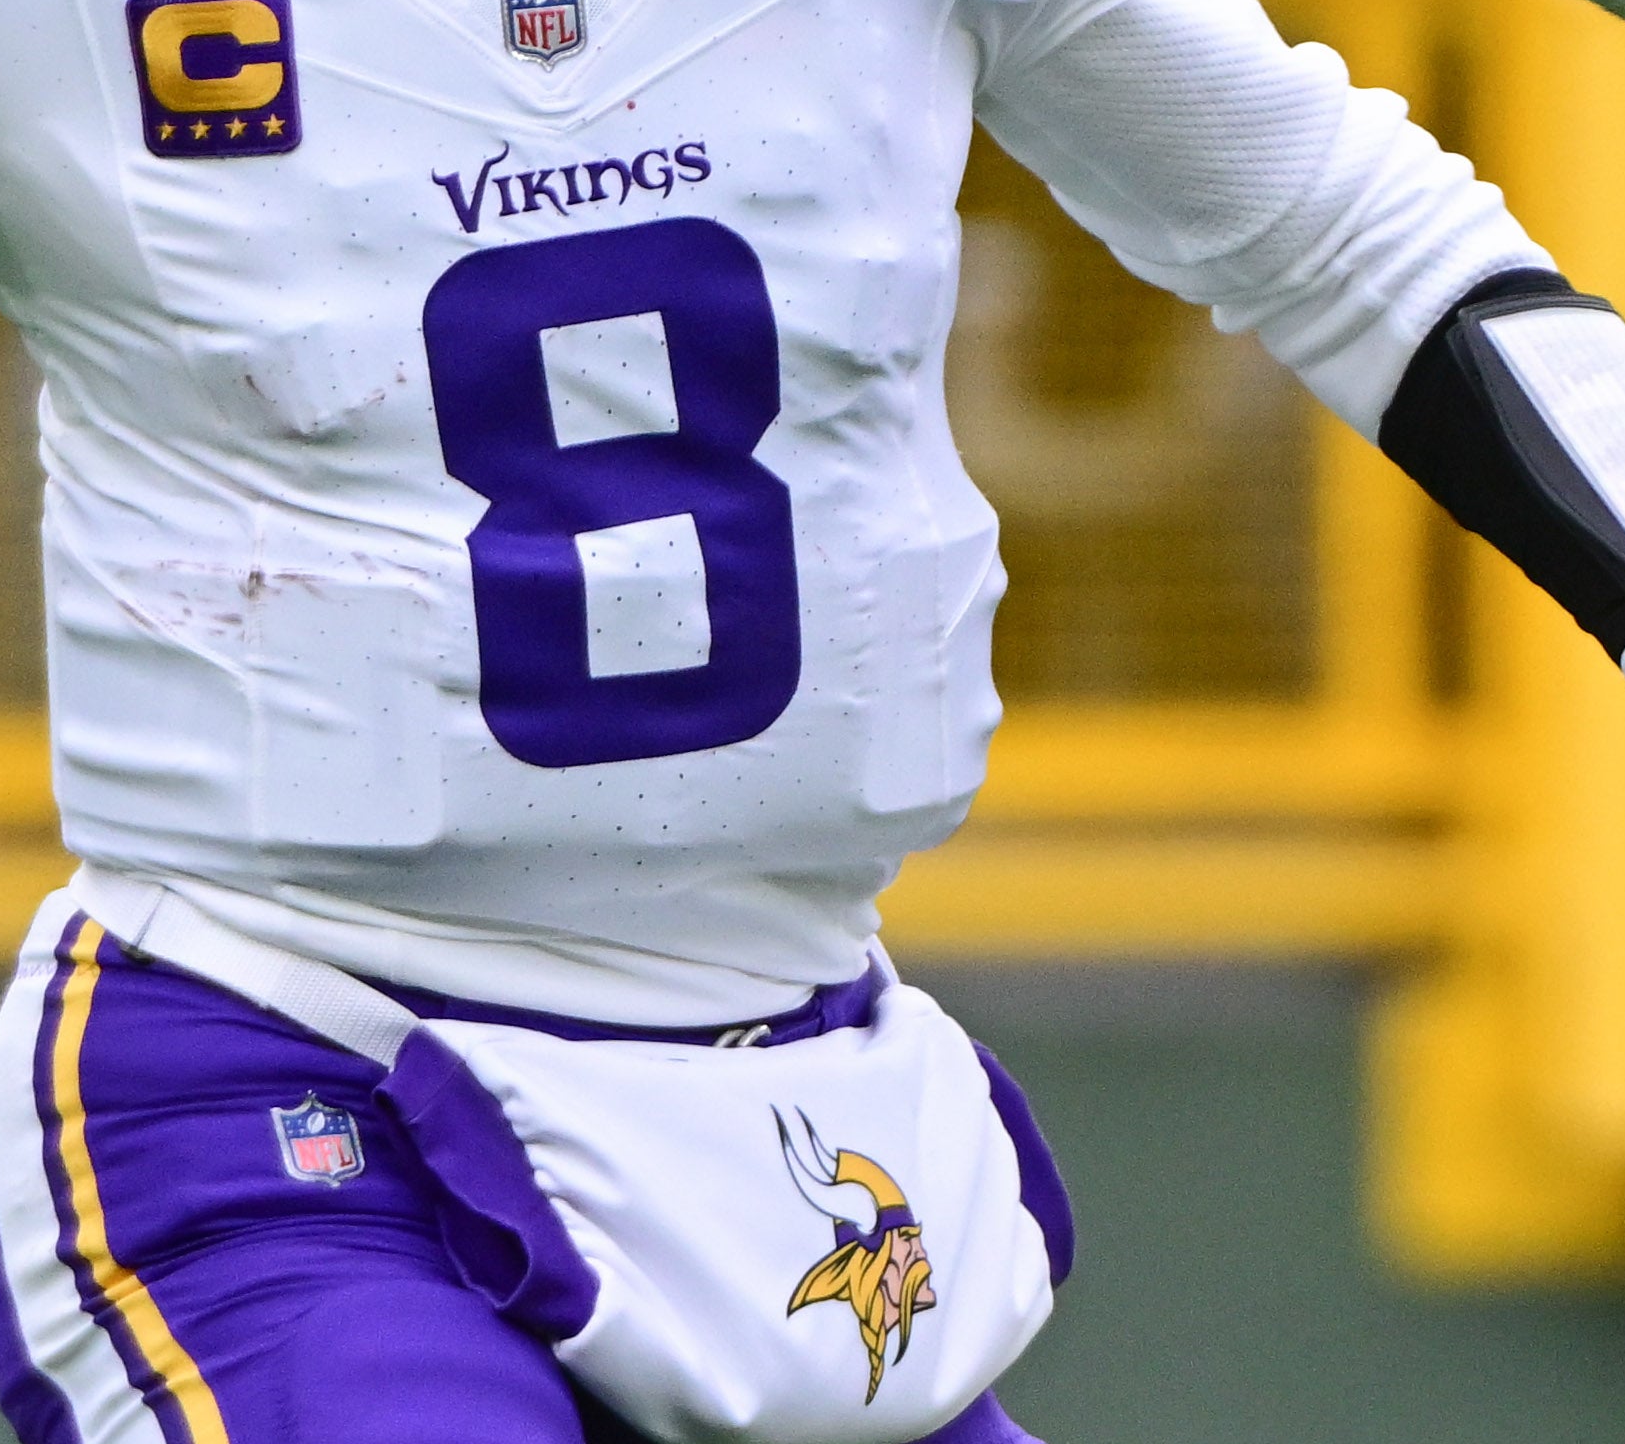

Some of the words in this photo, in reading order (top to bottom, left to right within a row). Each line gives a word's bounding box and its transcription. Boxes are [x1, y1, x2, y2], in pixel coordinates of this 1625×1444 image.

[516, 9, 576, 50] NFL
[422, 214, 803, 769] 8
[293, 1135, 353, 1172] NFL
